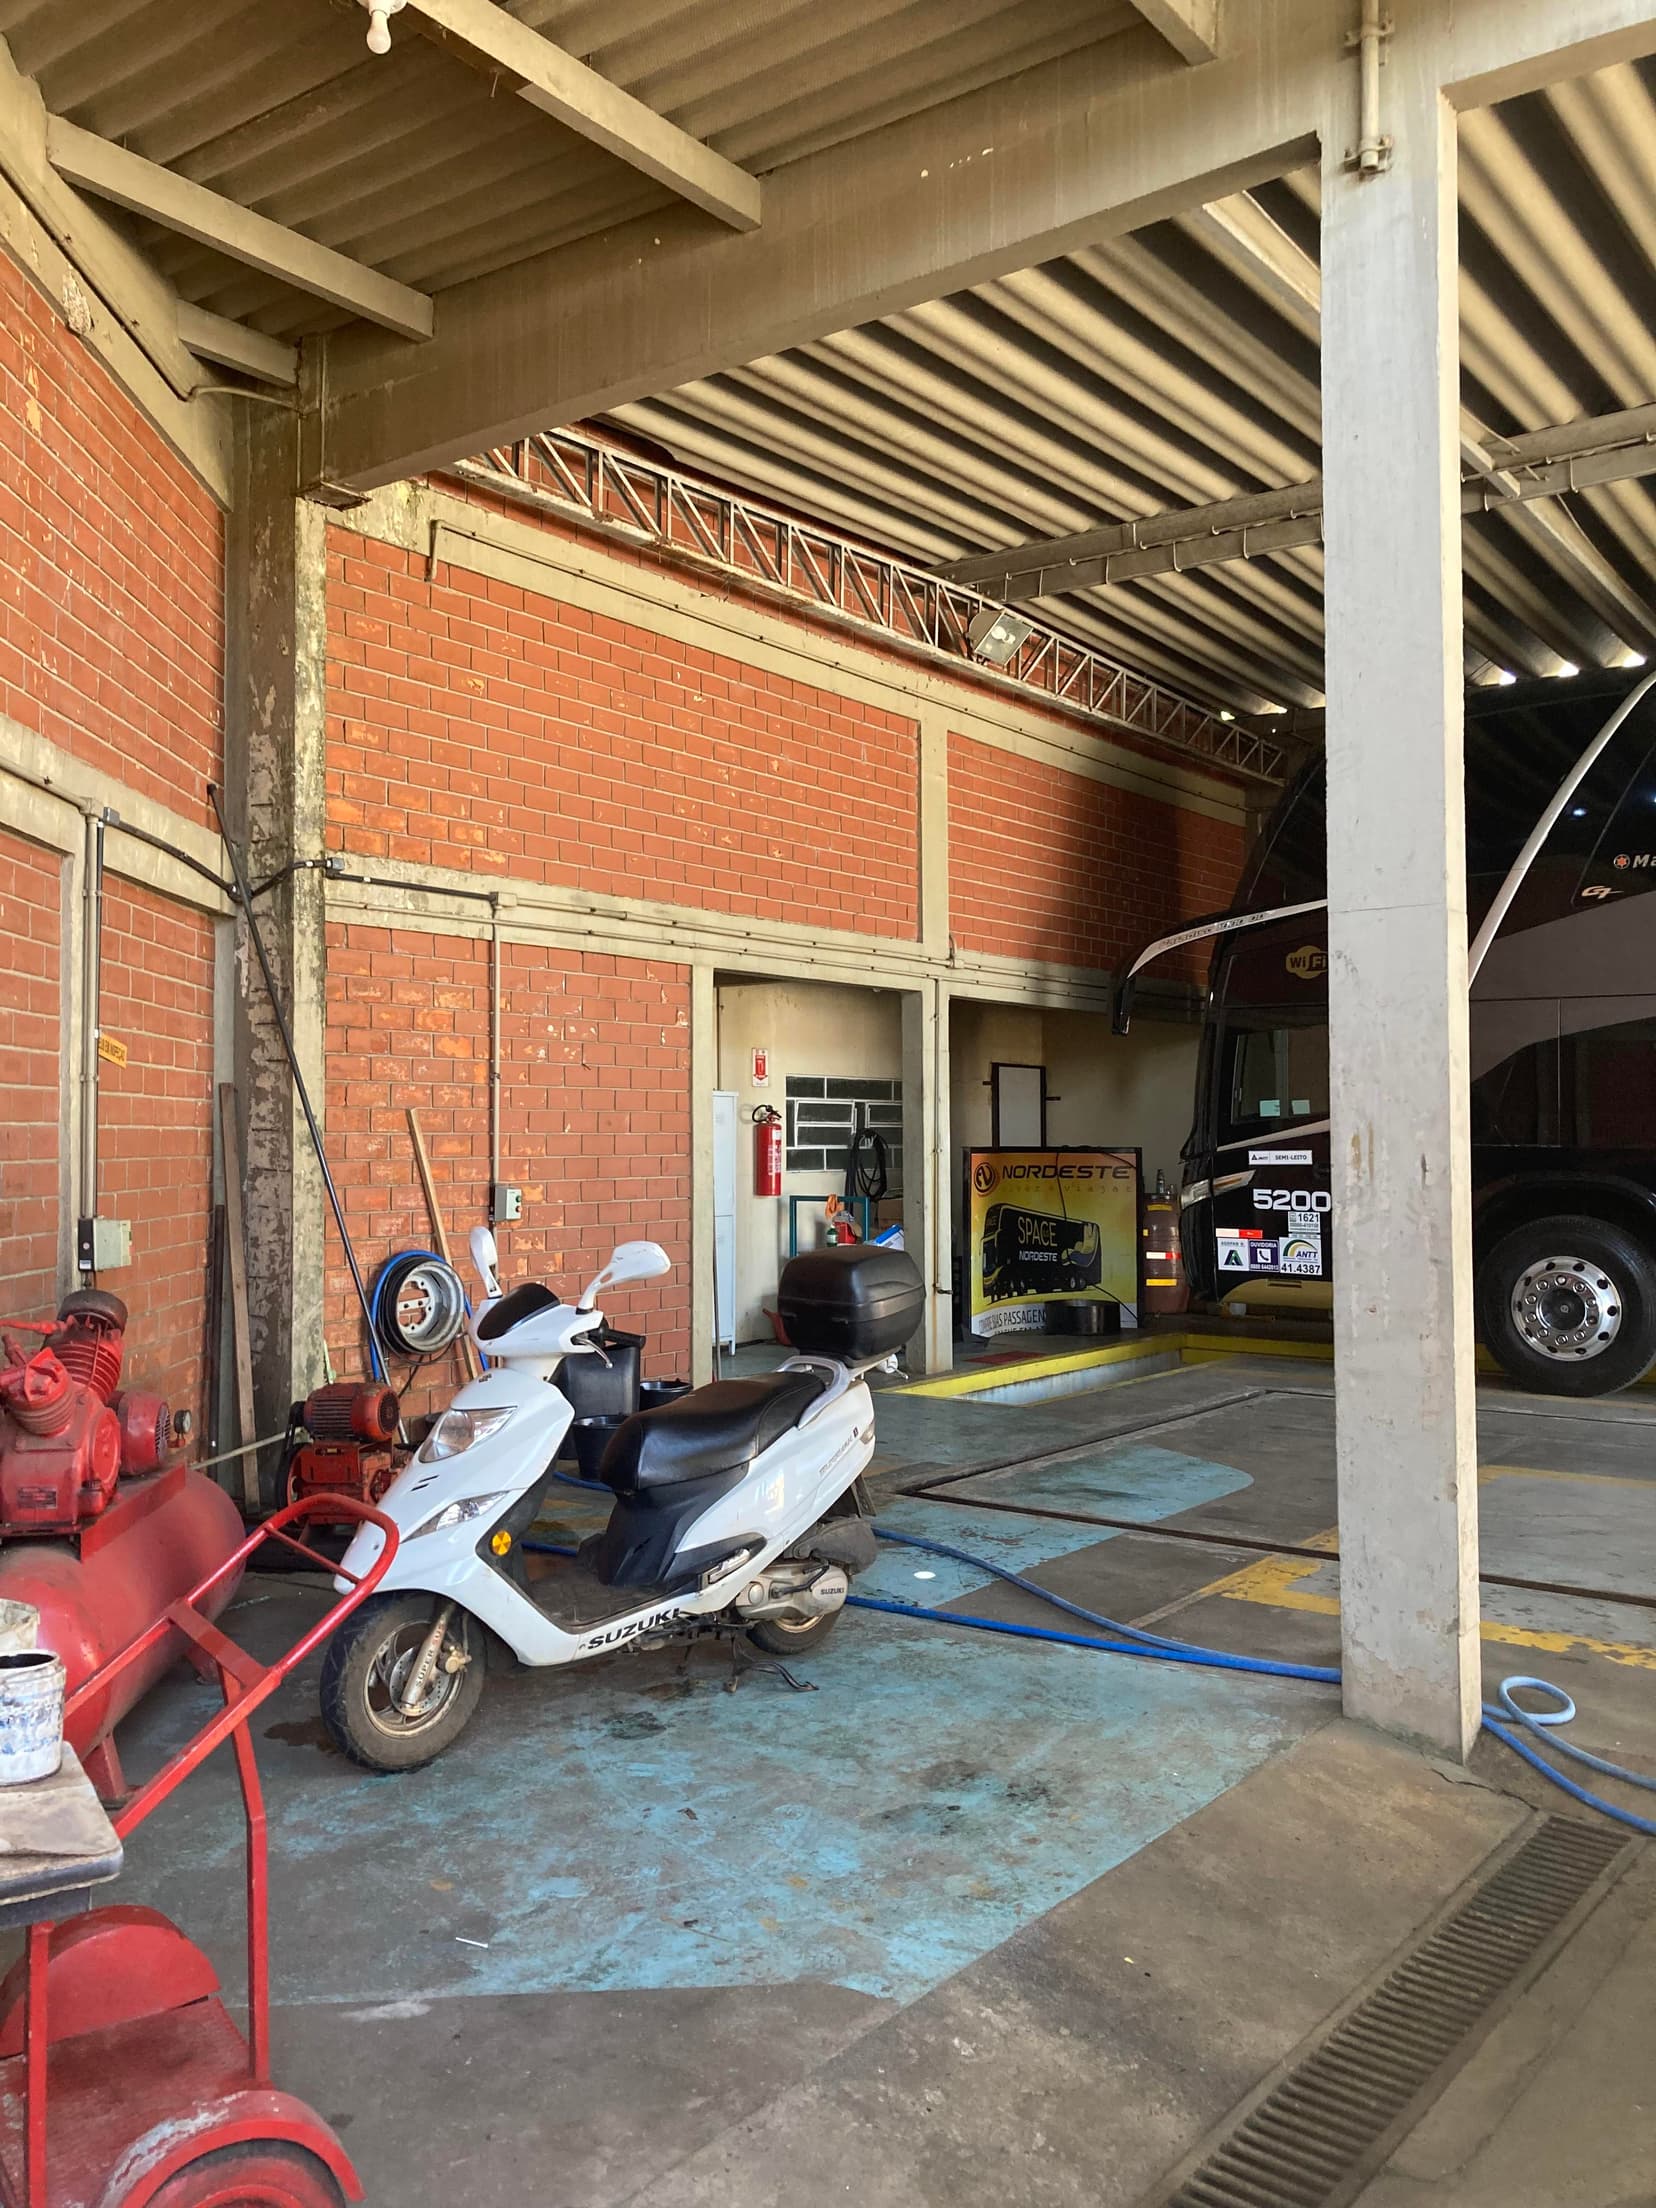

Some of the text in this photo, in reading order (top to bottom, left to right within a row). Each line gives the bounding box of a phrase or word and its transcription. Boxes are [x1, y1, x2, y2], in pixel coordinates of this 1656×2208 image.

[1003, 1165, 1132, 1179] NORDESTE
[1253, 1188, 1331, 1212] 5200
[1298, 1213, 1319, 1222] 1621
[1018, 1216, 1057, 1247] SPACE
[1019, 1250, 1057, 1262] NORDESTE
[1295, 1251, 1318, 1259] ANTT
[1281, 1263, 1320, 1273] 41.4387
[820, 1587, 845, 1595] SUZUKI
[587, 1608, 680, 1650] SUZUKI
